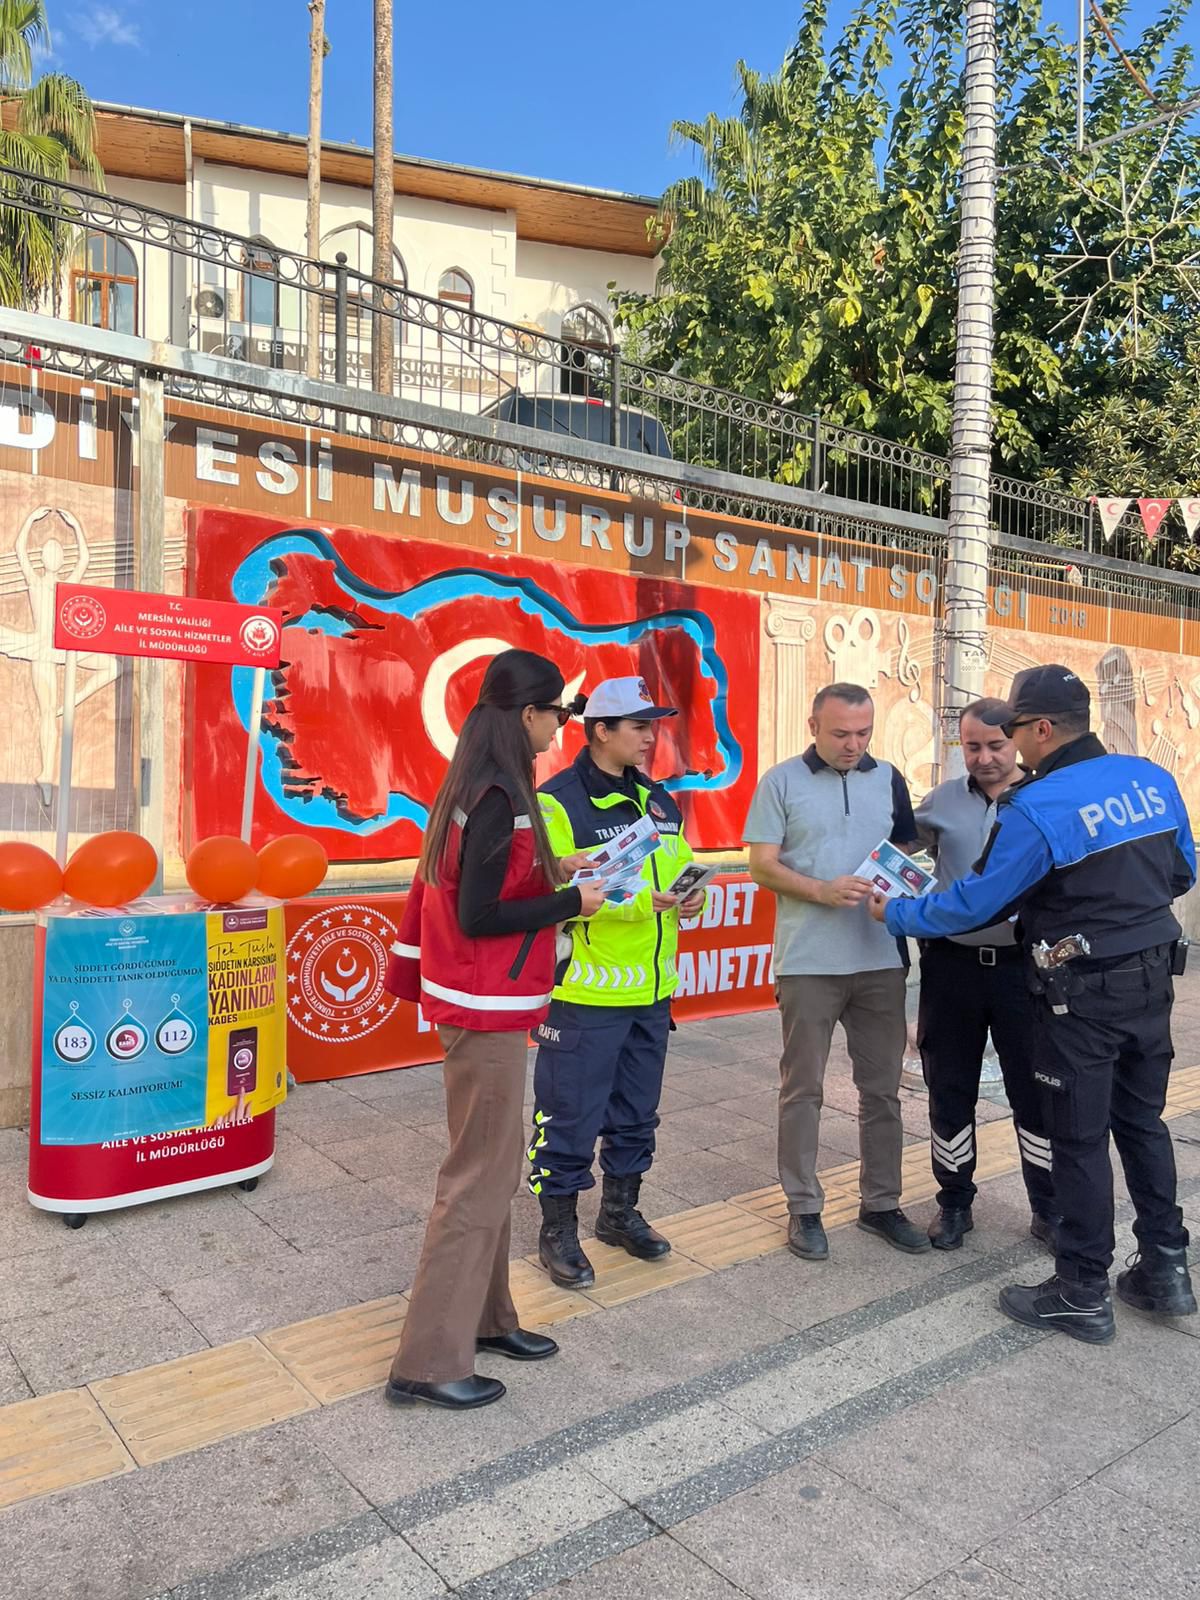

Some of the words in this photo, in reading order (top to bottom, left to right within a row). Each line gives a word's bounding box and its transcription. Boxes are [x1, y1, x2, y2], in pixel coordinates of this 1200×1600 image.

[373, 462, 691, 562] MUŞURUP
[713, 530, 873, 593] SANAT
[889, 563, 1026, 619] SOĞI
[1049, 604, 1087, 629] 2018
[169, 602, 184, 611] T.C.
[138, 612, 173, 624] MERSİN
[175, 616, 212, 628] VALİLİĞİ
[114, 623, 134, 633] AİLE
[136, 627, 148, 635] VE
[150, 627, 182, 639] SOSYAL
[184, 630, 232, 644] HİZMETLER
[139, 639, 147, 649] İL
[149, 640, 208, 654] MÜDÜRLÜĞÜ
[1078, 780, 1167, 838] POLİS
[680, 882, 759, 931] DET
[321, 934, 337, 947] AİLE
[336, 929, 347, 937] VE
[347, 929, 373, 944] SOSYAL
[48, 975, 58, 983] YA
[60, 975, 72, 983] DA
[117, 971, 144, 982] TANIK
[74, 962, 109, 974] ŞİDDET
[208, 963, 277, 991] KADINLARIN
[209, 983, 275, 1016] YANINDA
[63, 1036, 88, 1049] 183
[164, 1029, 188, 1043] 112
[71, 1089, 105, 1101] SESSİZ
[108, 1080, 184, 1099] KALMIYORUM!
[136, 1151, 147, 1163] İL
[150, 1135, 225, 1161] MÜDÜRLÜĞÜ
